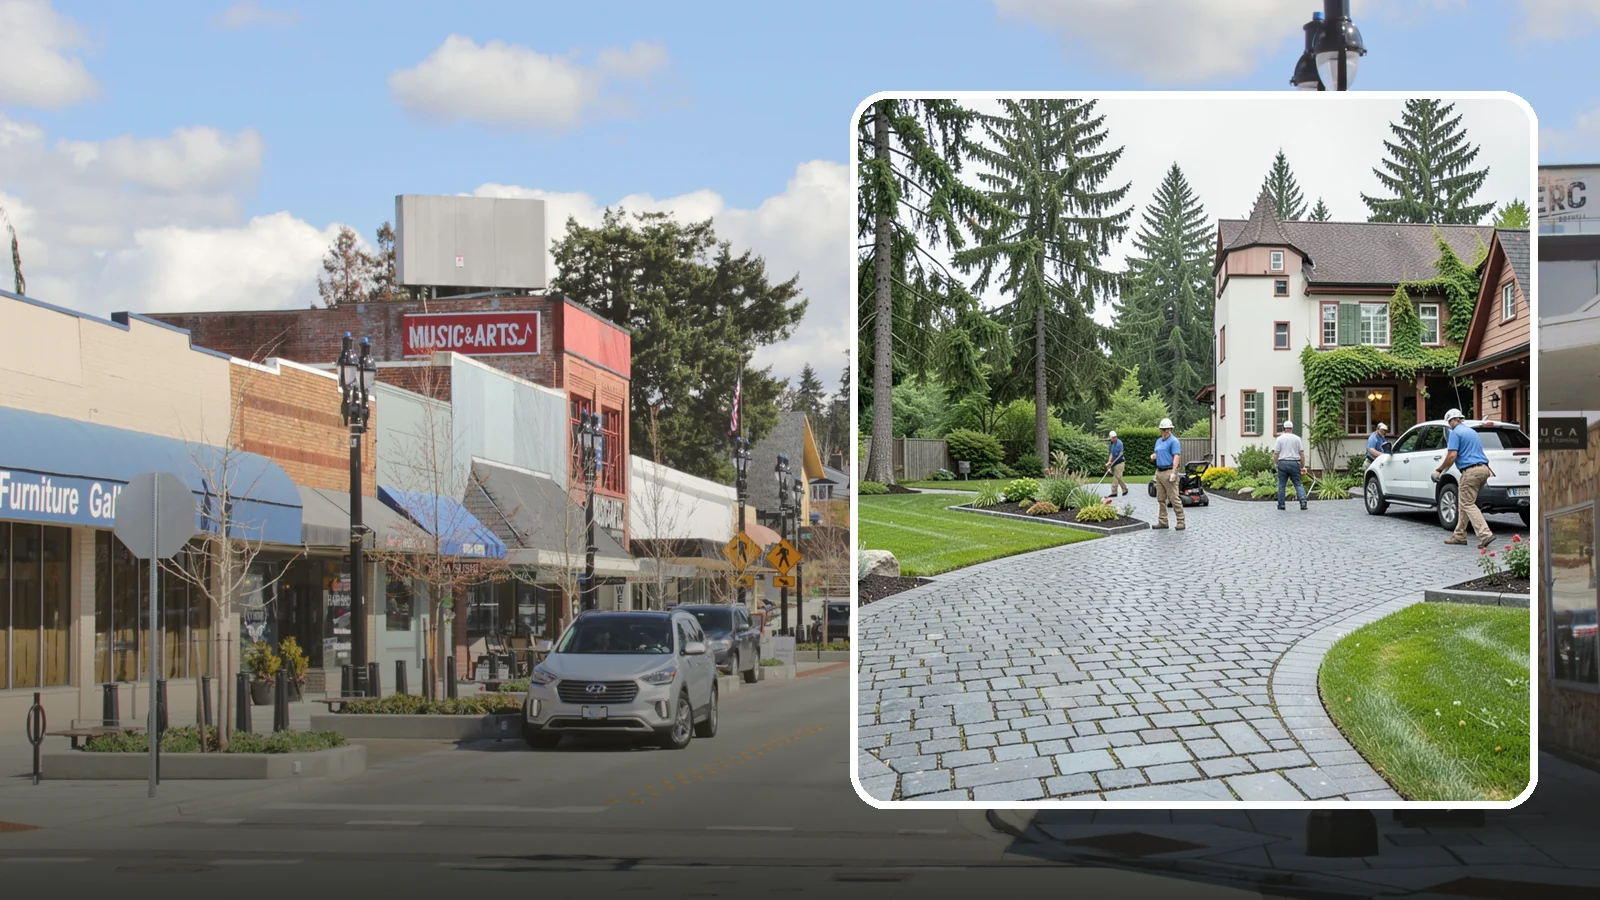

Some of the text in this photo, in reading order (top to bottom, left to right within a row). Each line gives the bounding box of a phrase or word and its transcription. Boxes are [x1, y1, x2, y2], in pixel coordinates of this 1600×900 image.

[408, 322, 520, 348] MUSIC&ARTS
[1540, 427, 1577, 437] UGA
[0, 471, 122, 519] Furniture Gal
